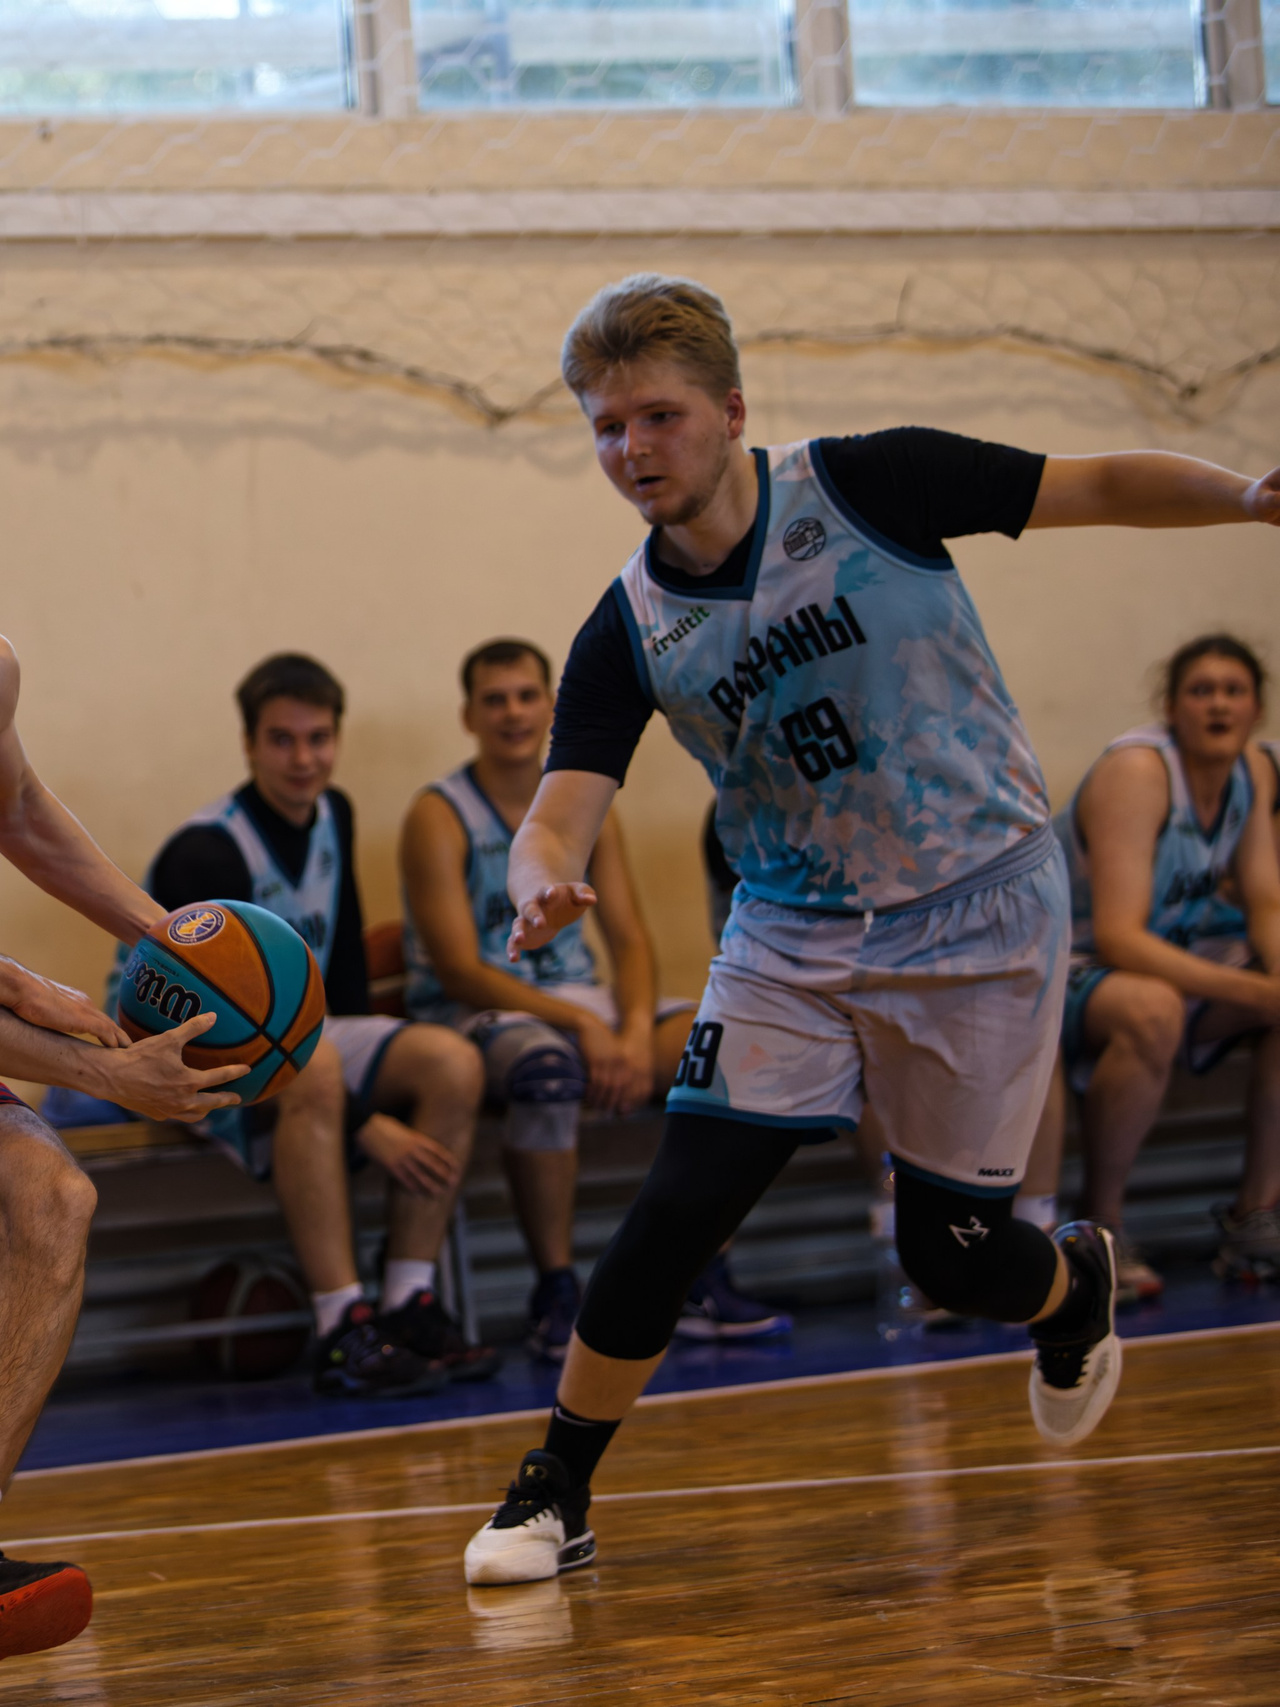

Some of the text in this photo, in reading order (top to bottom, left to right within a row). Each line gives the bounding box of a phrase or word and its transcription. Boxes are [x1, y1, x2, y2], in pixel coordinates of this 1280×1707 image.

[651, 604, 711, 657] fruitit
[708, 596, 867, 728] ВАРАНЫ
[780, 697, 858, 782] 69
